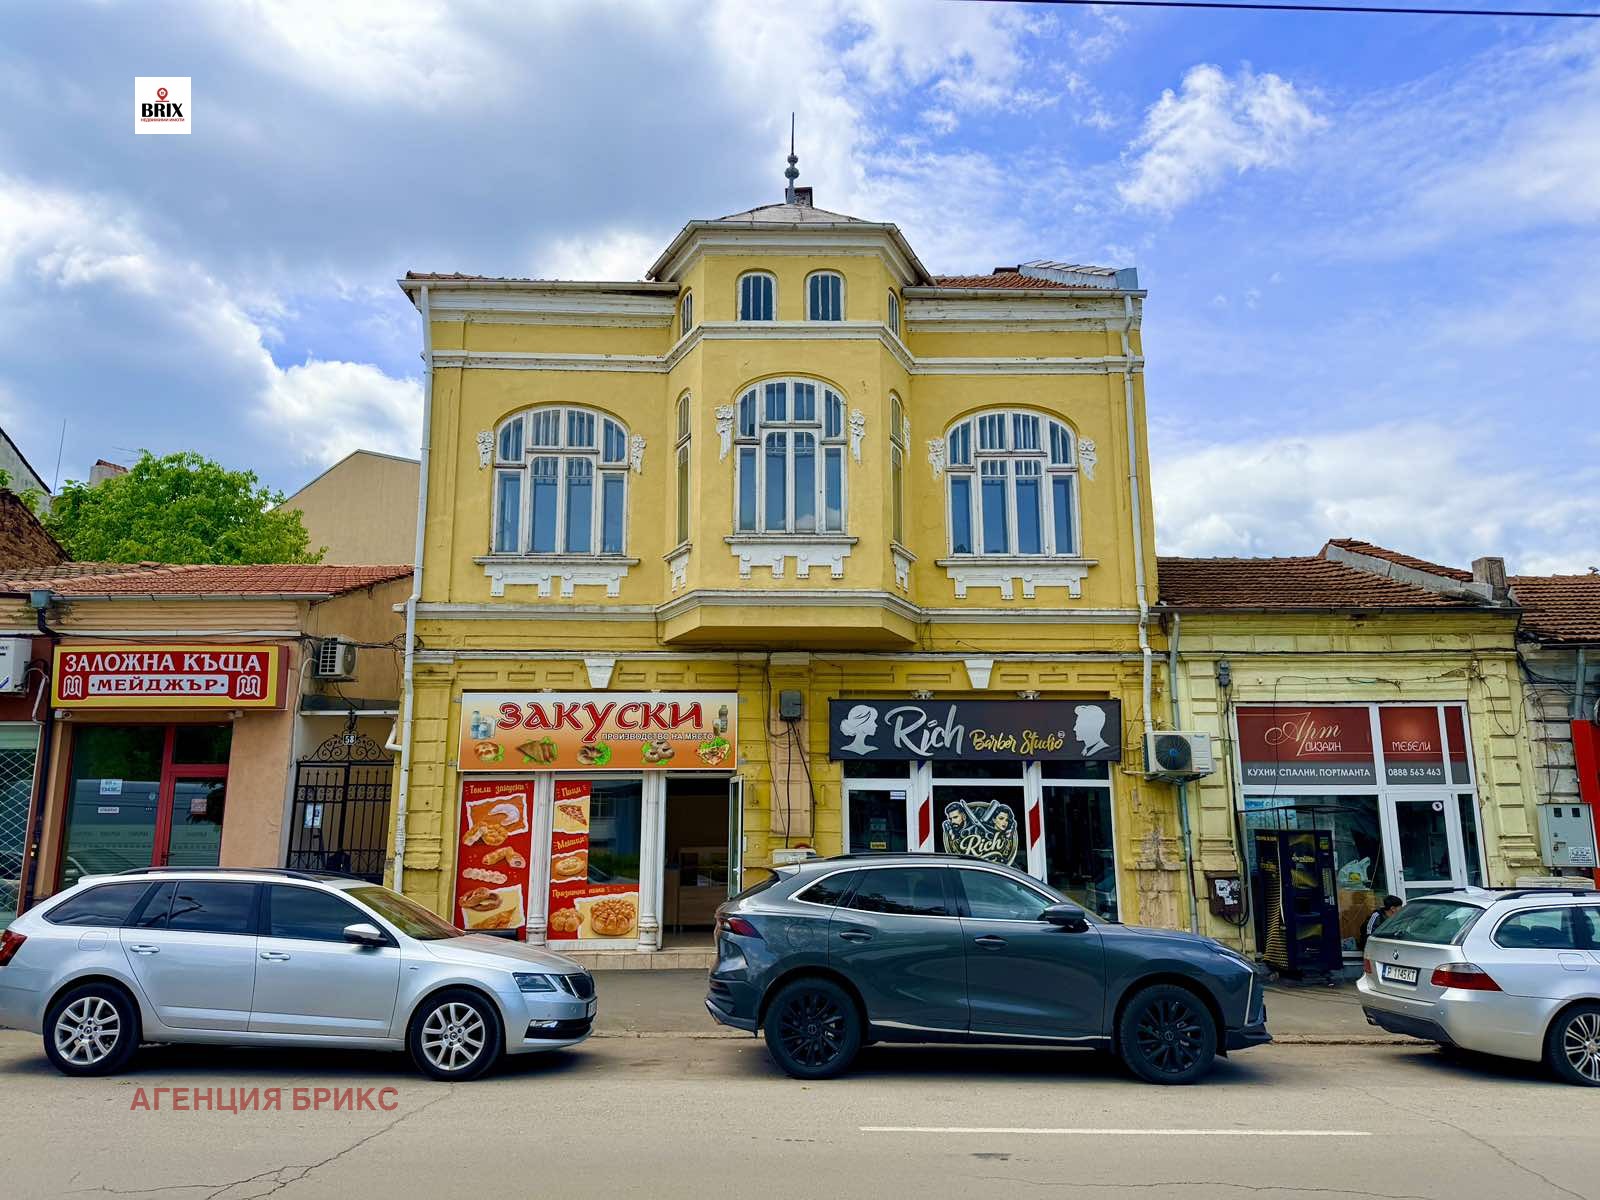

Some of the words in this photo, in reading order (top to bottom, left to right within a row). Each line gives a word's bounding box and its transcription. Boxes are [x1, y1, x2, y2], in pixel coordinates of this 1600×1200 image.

[65, 653, 176, 672] ЗАЛОЖНА
[183, 654, 262, 673] КЪЩА
[96, 676, 219, 692] МЕЙДЖЪР
[497, 701, 704, 743] ЗАКУСКИ
[602, 732, 669, 741] ПРОИЗВОДСТВО
[671, 732, 683, 741] НА
[685, 732, 714, 741] МЯСТО
[884, 704, 965, 757] Rich
[969, 729, 1016, 753] Barber
[1392, 741, 1432, 752] МЕБЕЛИ
[1319, 768, 1371, 777] ПОРТМАНТА
[1388, 768, 1408, 777] 0888
[1410, 768, 1425, 777] 563
[1427, 768, 1441, 777] 463
[960, 832, 1005, 858] Rich
